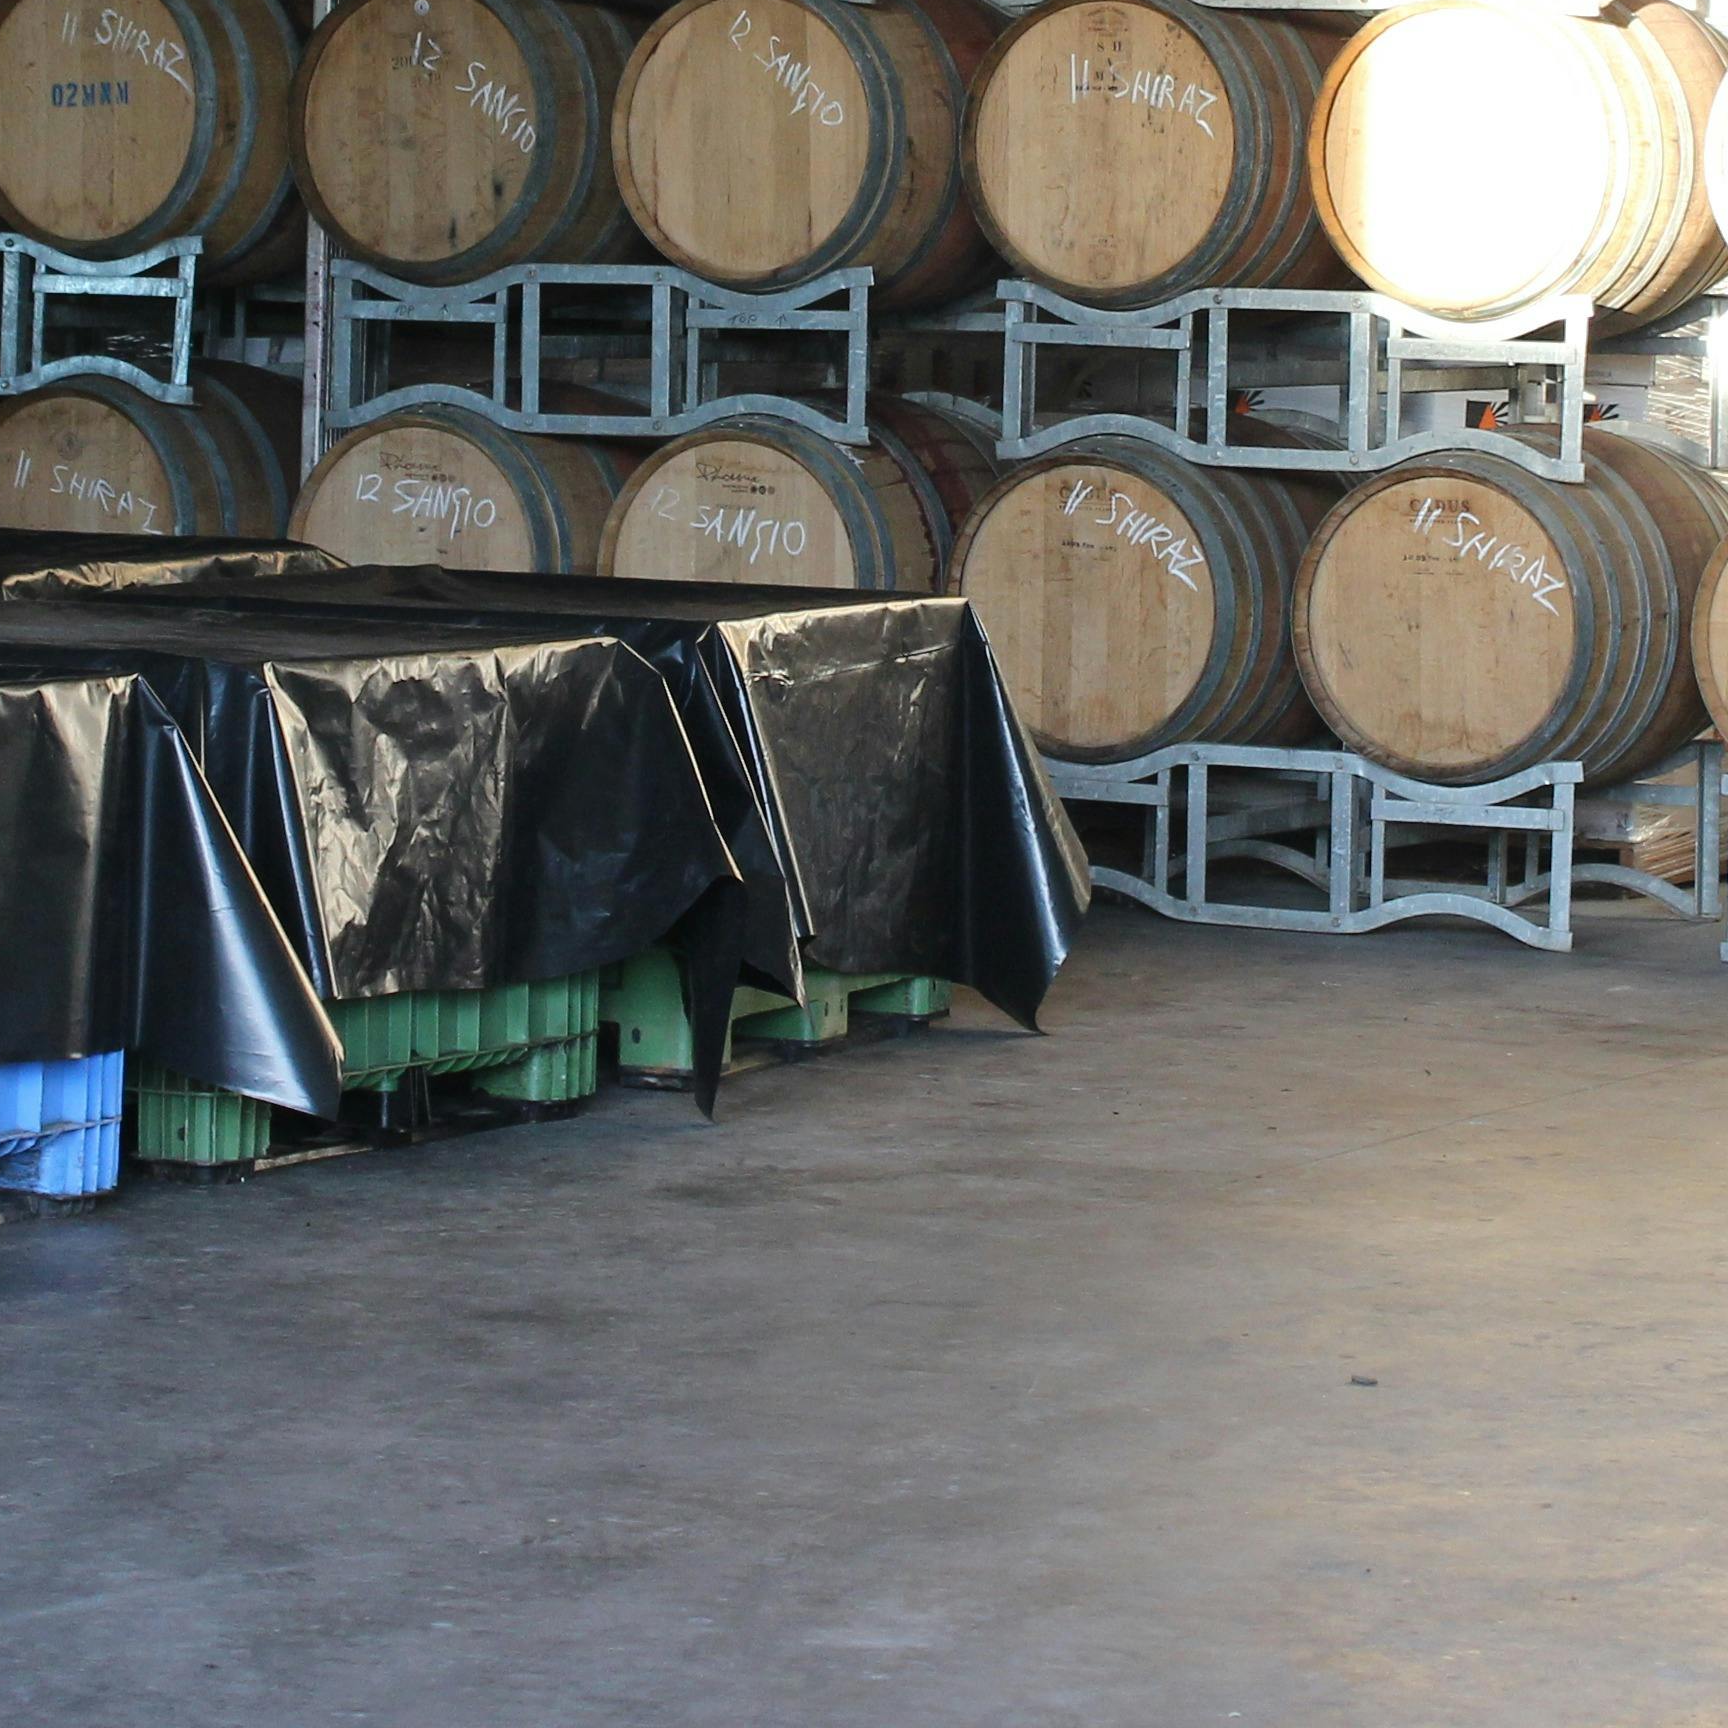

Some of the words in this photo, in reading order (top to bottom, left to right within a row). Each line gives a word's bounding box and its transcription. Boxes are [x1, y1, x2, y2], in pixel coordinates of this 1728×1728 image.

[94, 7, 194, 98] SHIRAZ
[1109, 60, 1218, 140] SHIRAZ
[48, 464, 165, 536] SHIRAZ
[356, 473, 383, 503] 12
[391, 478, 497, 540] SANGIO
[1409, 498, 1471, 512] CDUS
[1095, 492, 1204, 593] SHIRAZ
[1442, 511, 1565, 617] SHIRAZ
